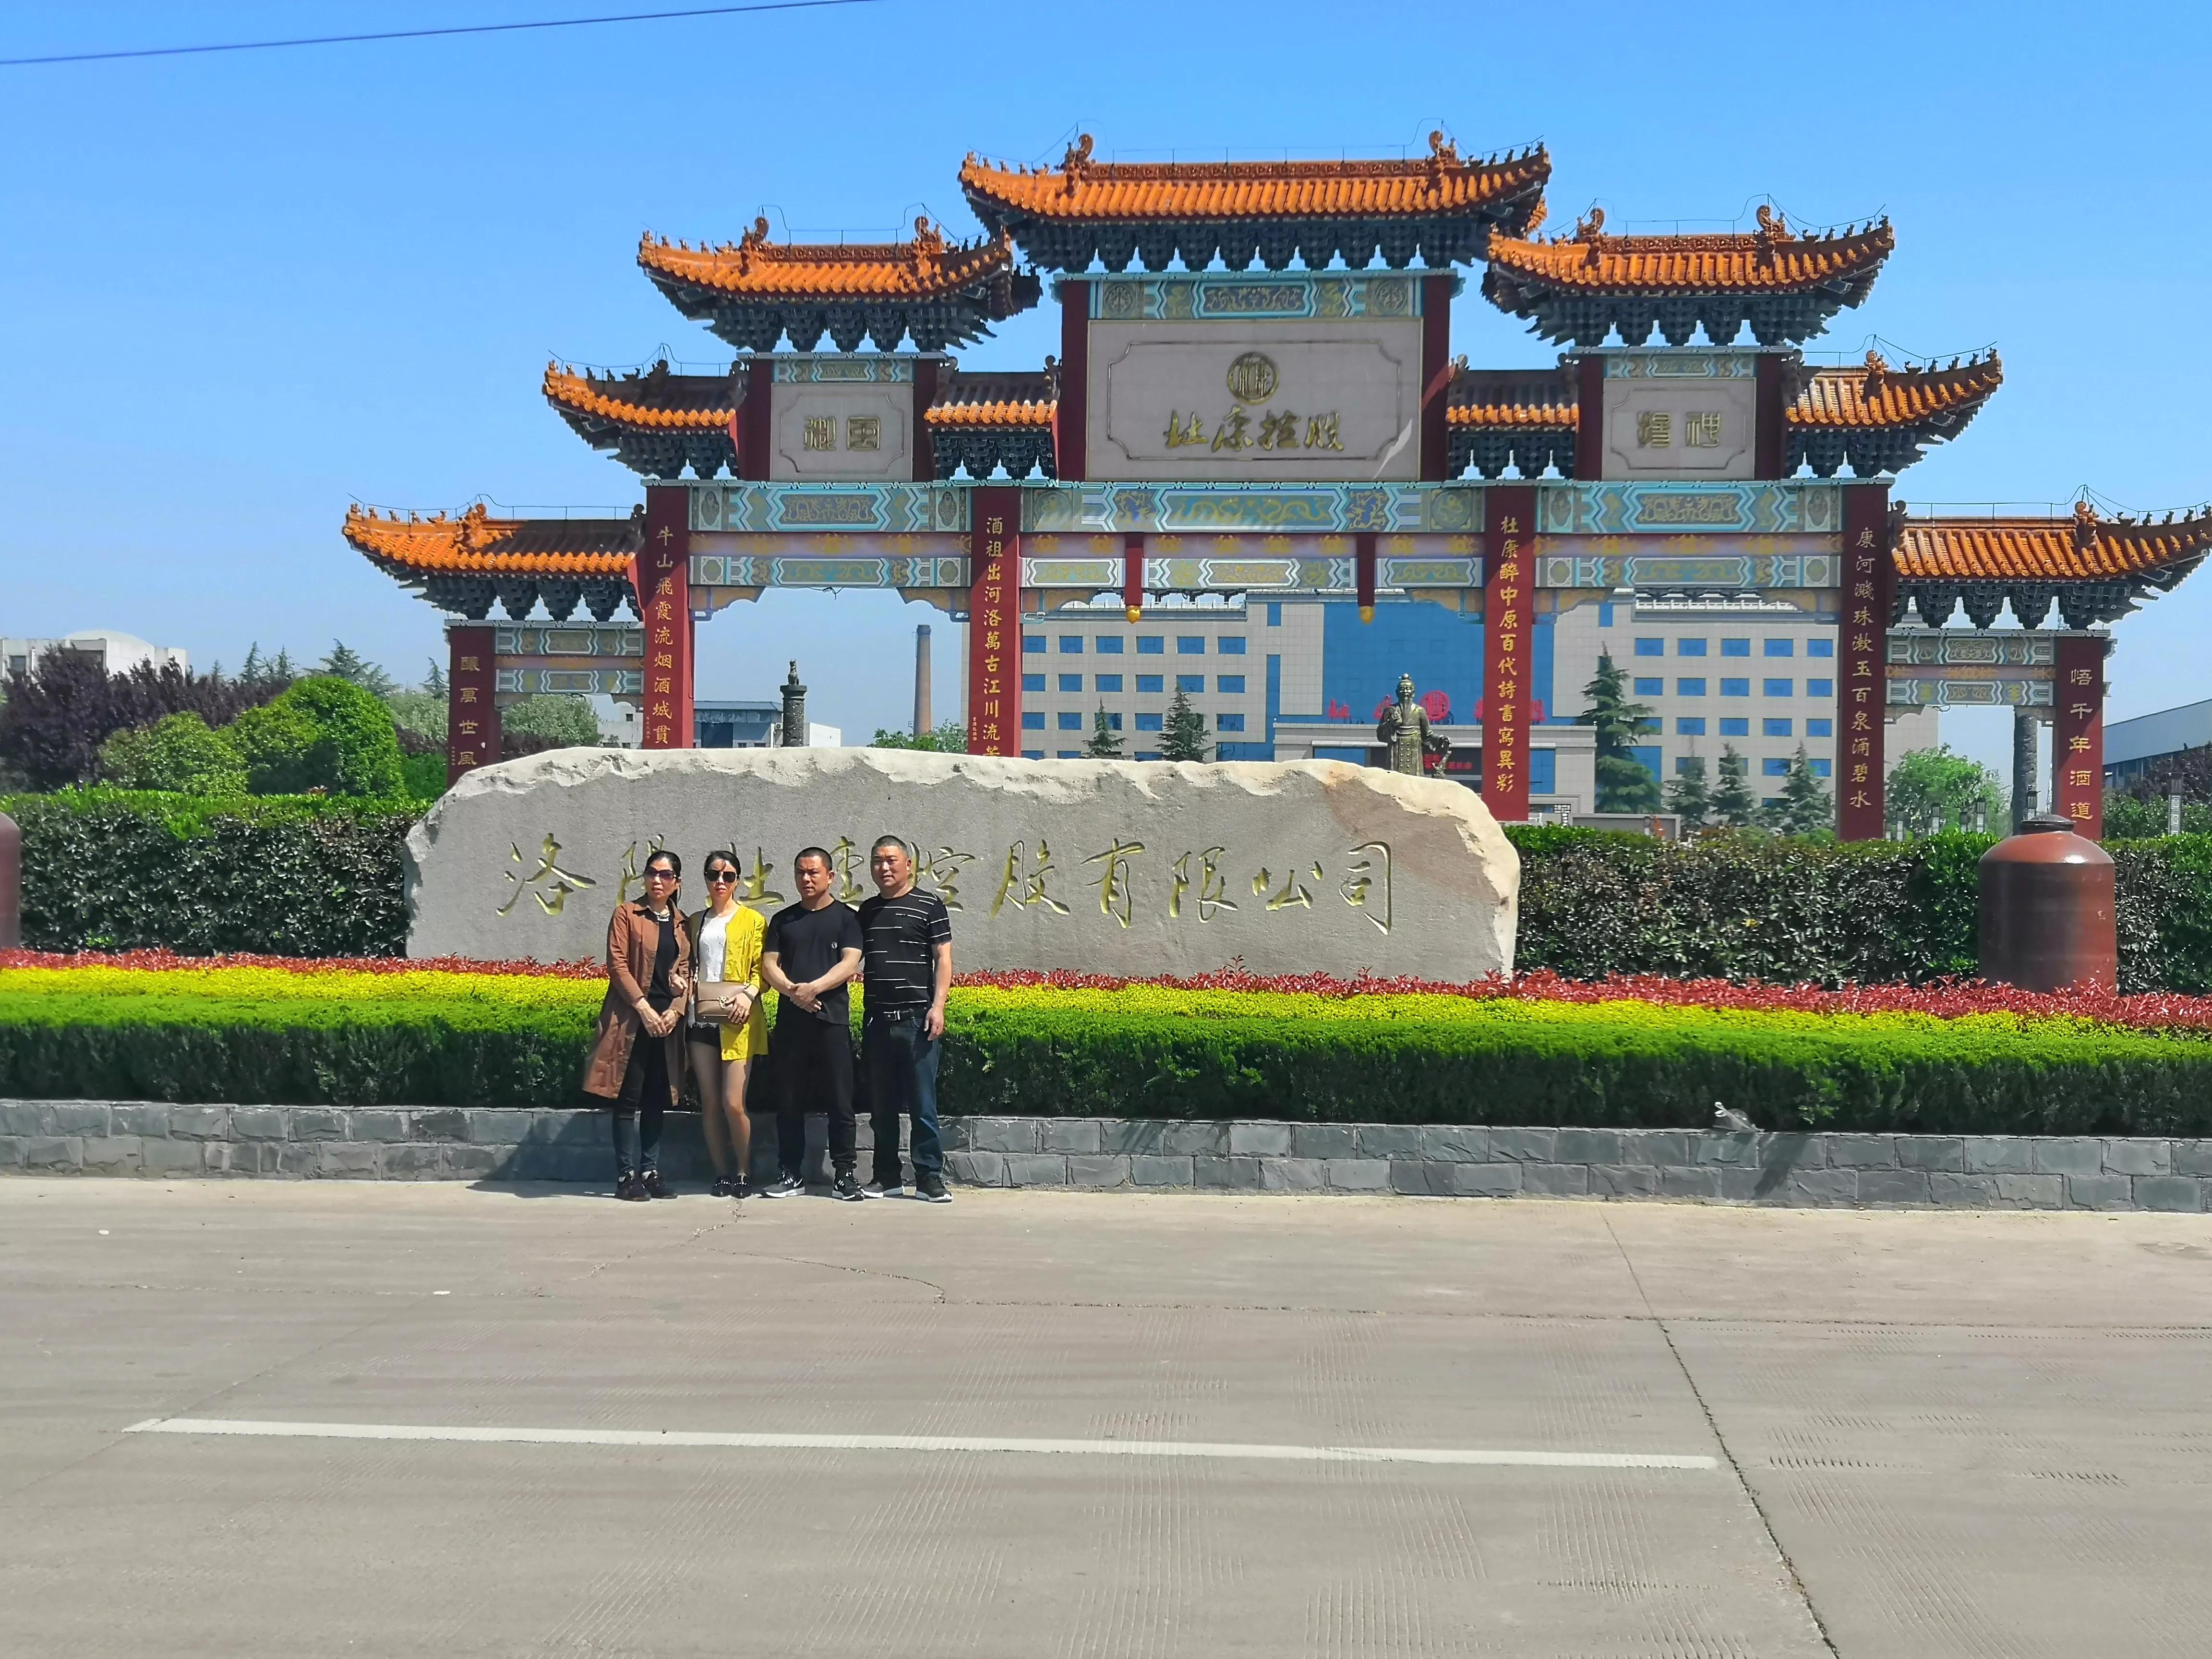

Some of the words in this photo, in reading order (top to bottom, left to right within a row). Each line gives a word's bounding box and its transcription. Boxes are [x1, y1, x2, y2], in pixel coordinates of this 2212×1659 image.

[1163, 404, 1345, 453] 杜康控股
[2068, 668, 2093, 820] 悟千年酒道
